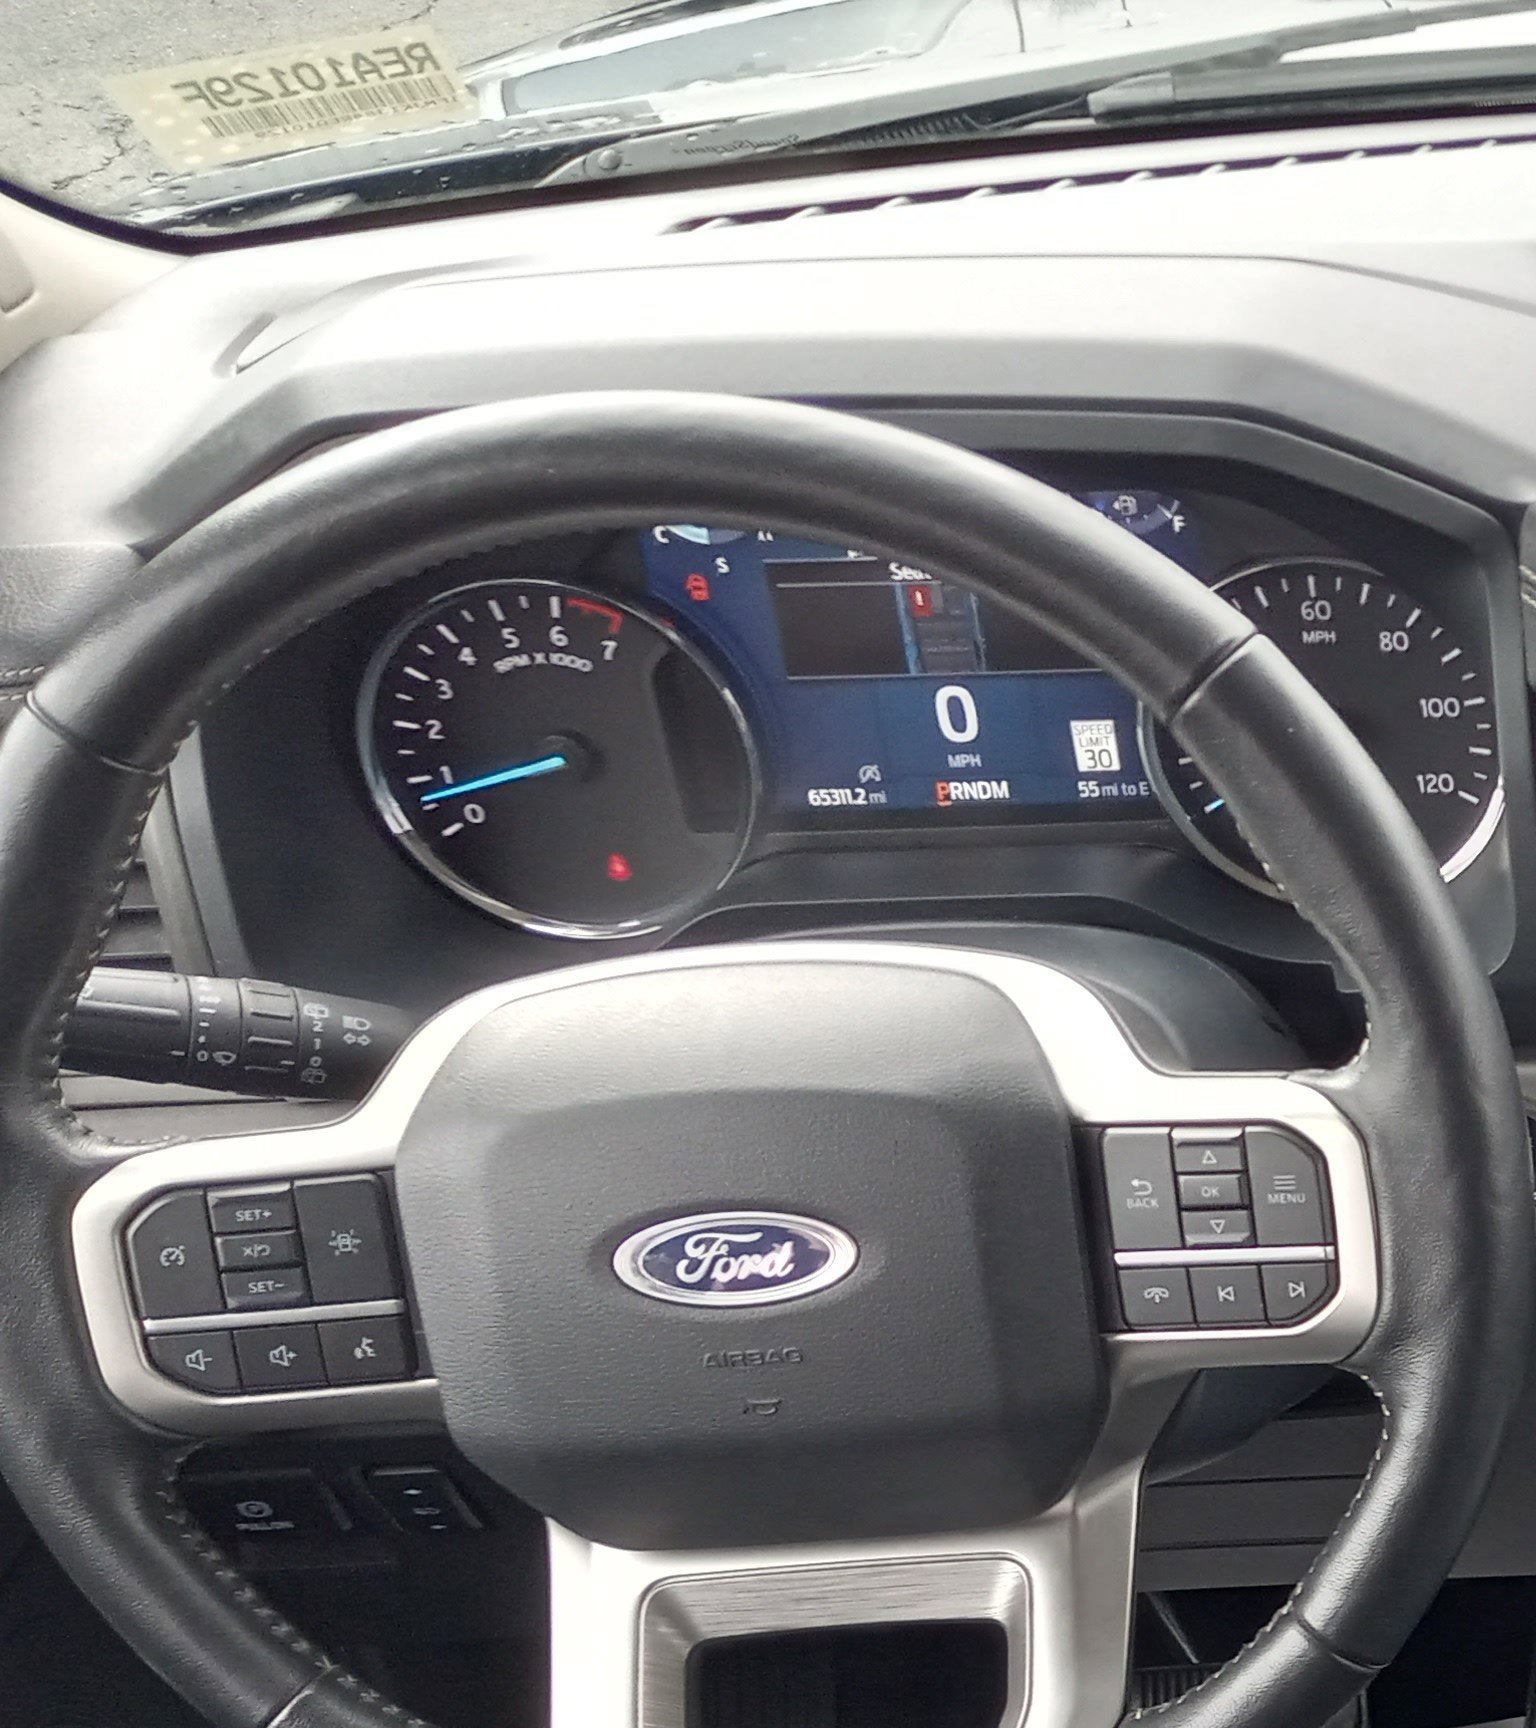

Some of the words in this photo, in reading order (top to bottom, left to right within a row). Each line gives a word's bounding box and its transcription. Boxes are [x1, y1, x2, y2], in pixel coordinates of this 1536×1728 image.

[1172, 515, 1187, 533] F
[714, 557, 730, 575] S
[1300, 600, 1332, 621] 60
[501, 627, 520, 648] 5
[549, 625, 569, 647] 6
[1301, 629, 1337, 645] MPH
[1378, 631, 1410, 652] 80
[458, 646, 478, 666] 4
[600, 639, 618, 661] 7
[548, 652, 594, 673] 1000
[435, 678, 454, 700] 3
[934, 684, 979, 743] 0
[1419, 697, 1461, 718] 100
[425, 719, 446, 740] 2
[1073, 724, 1114, 736] SPEED
[1079, 736, 1111, 748] LIMIT
[947, 753, 983, 768] MPH
[1084, 748, 1114, 769] 30
[439, 765, 454, 785] 1
[1416, 773, 1455, 794] 120
[868, 790, 888, 804] mi
[1077, 781, 1101, 798] 55
[1101, 783, 1120, 797] mi
[1121, 782, 1138, 796] to
[1139, 782, 1151, 796] E
[463, 803, 486, 824] 0
[312, 1020, 324, 1032] 2
[1201, 1187, 1221, 1198] OK
[1267, 1193, 1306, 1205] MENU
[1126, 1198, 1160, 1209] BACK
[235, 1208, 273, 1222] SET+
[675, 1231, 796, 1284] Ford
[701, 1346, 804, 1369] AIRBAG
